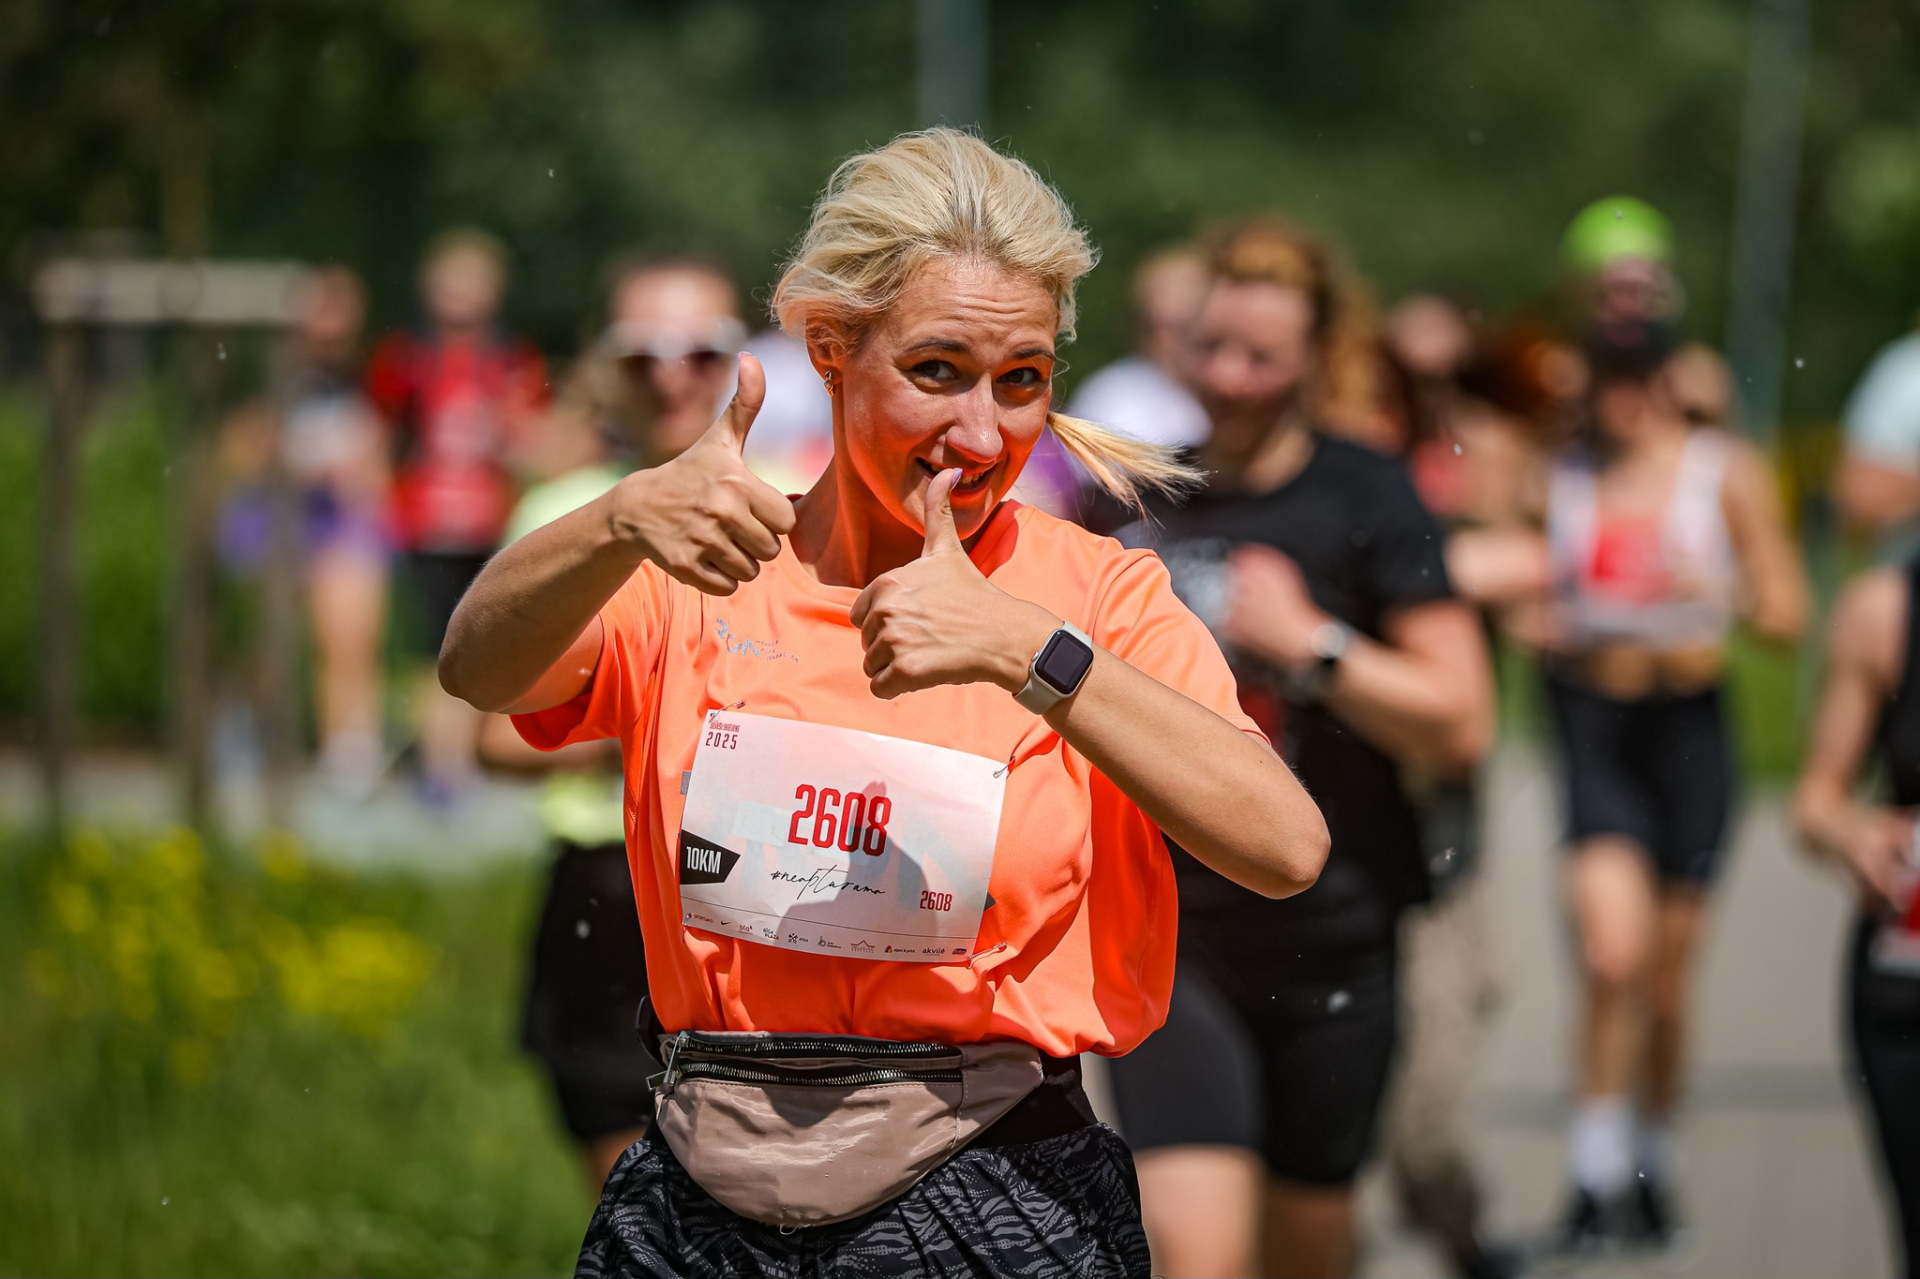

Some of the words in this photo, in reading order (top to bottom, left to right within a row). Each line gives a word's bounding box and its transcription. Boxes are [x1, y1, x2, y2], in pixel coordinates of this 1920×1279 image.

[705, 731, 738, 750] 2025
[788, 783, 892, 857] 2608
[686, 846, 721, 874] 10KM
[919, 890, 953, 912] 2608
